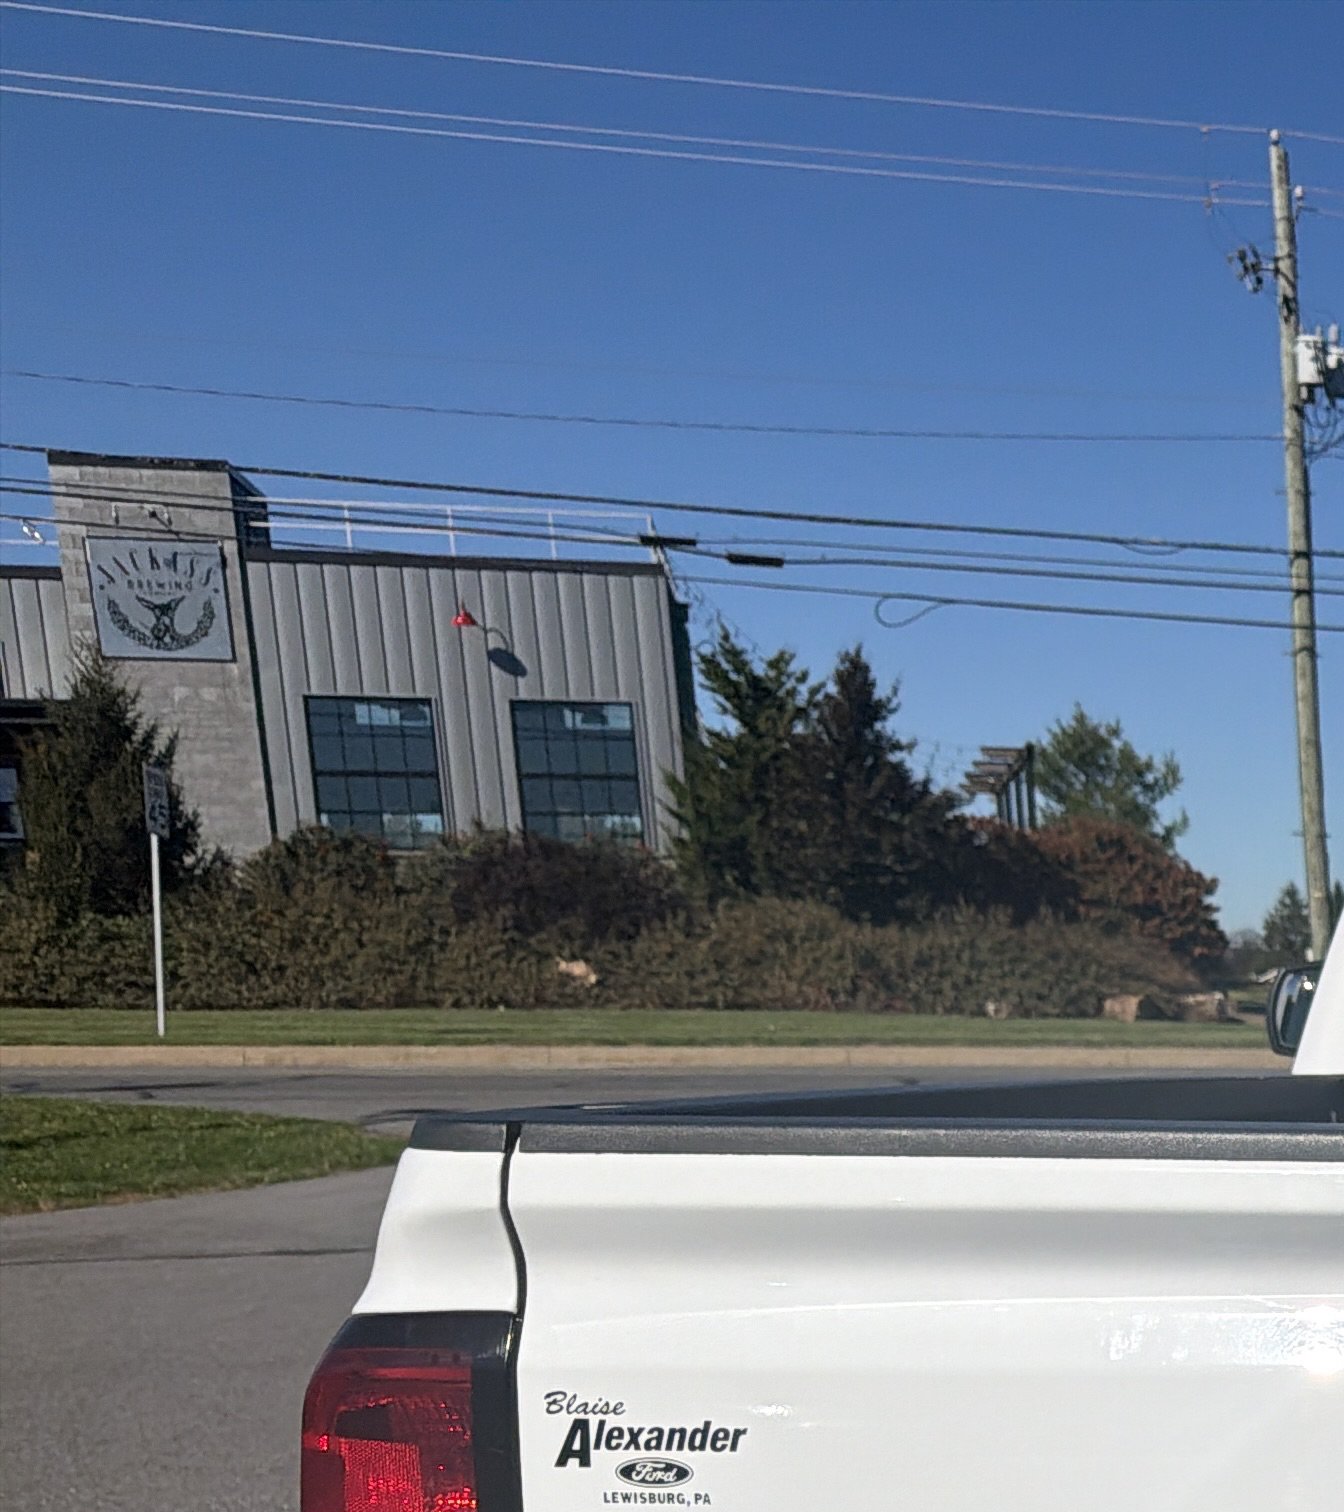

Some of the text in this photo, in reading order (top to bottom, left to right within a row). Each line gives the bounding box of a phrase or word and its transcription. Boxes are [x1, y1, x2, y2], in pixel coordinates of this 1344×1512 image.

[544, 1389, 626, 1416] Blaise
[554, 1417, 748, 1468] Alexander
[631, 1461, 678, 1483] Ford
[603, 1491, 712, 1507] LEWISBURG, PA
